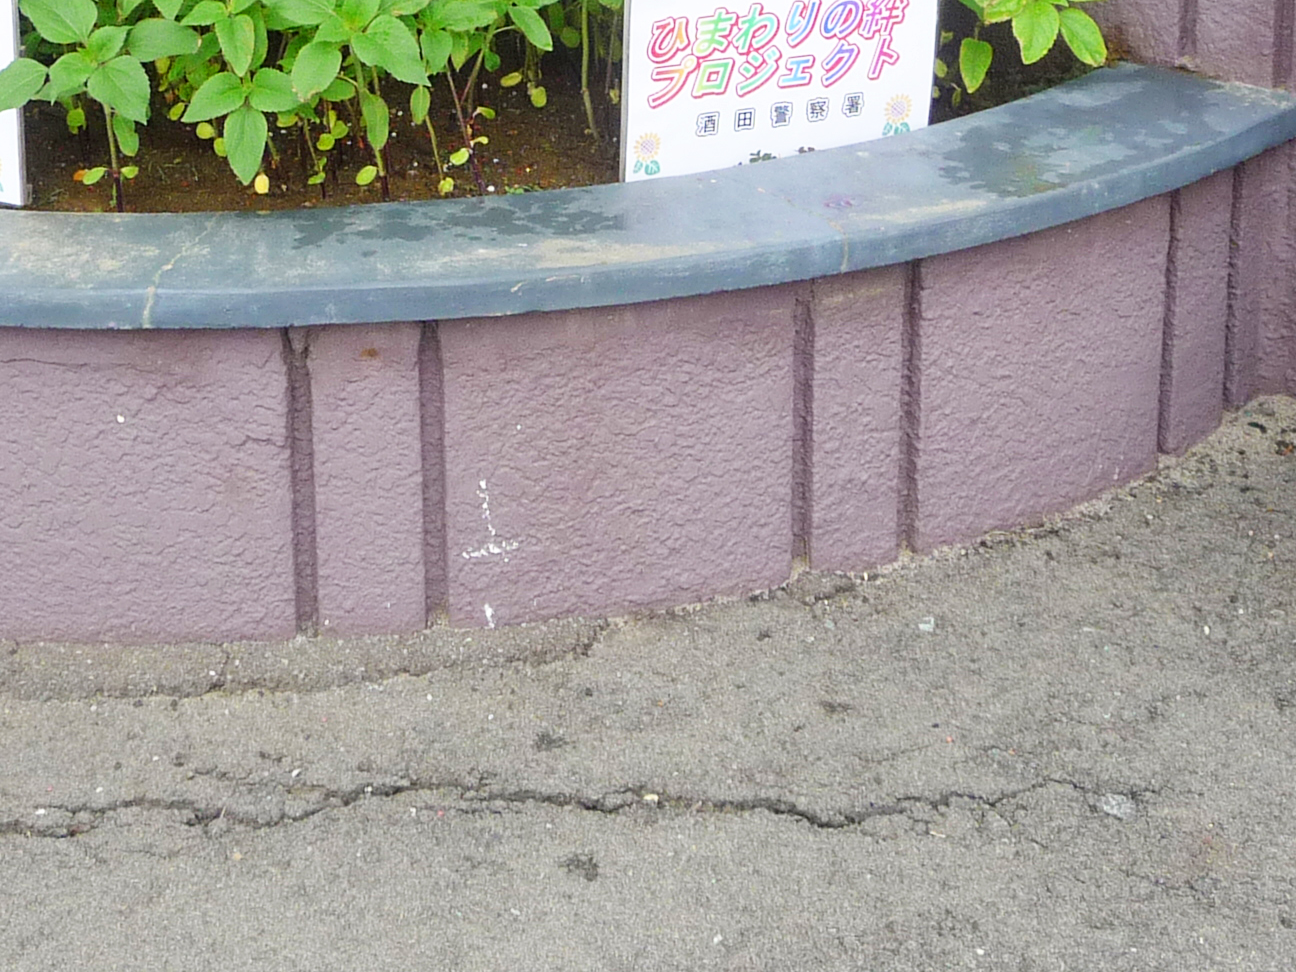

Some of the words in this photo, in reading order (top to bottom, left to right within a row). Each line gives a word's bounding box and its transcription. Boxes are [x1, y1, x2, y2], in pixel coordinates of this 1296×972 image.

[647, 34, 900, 109] プロジェクト
[696, 91, 865, 138] 酒田警察署
